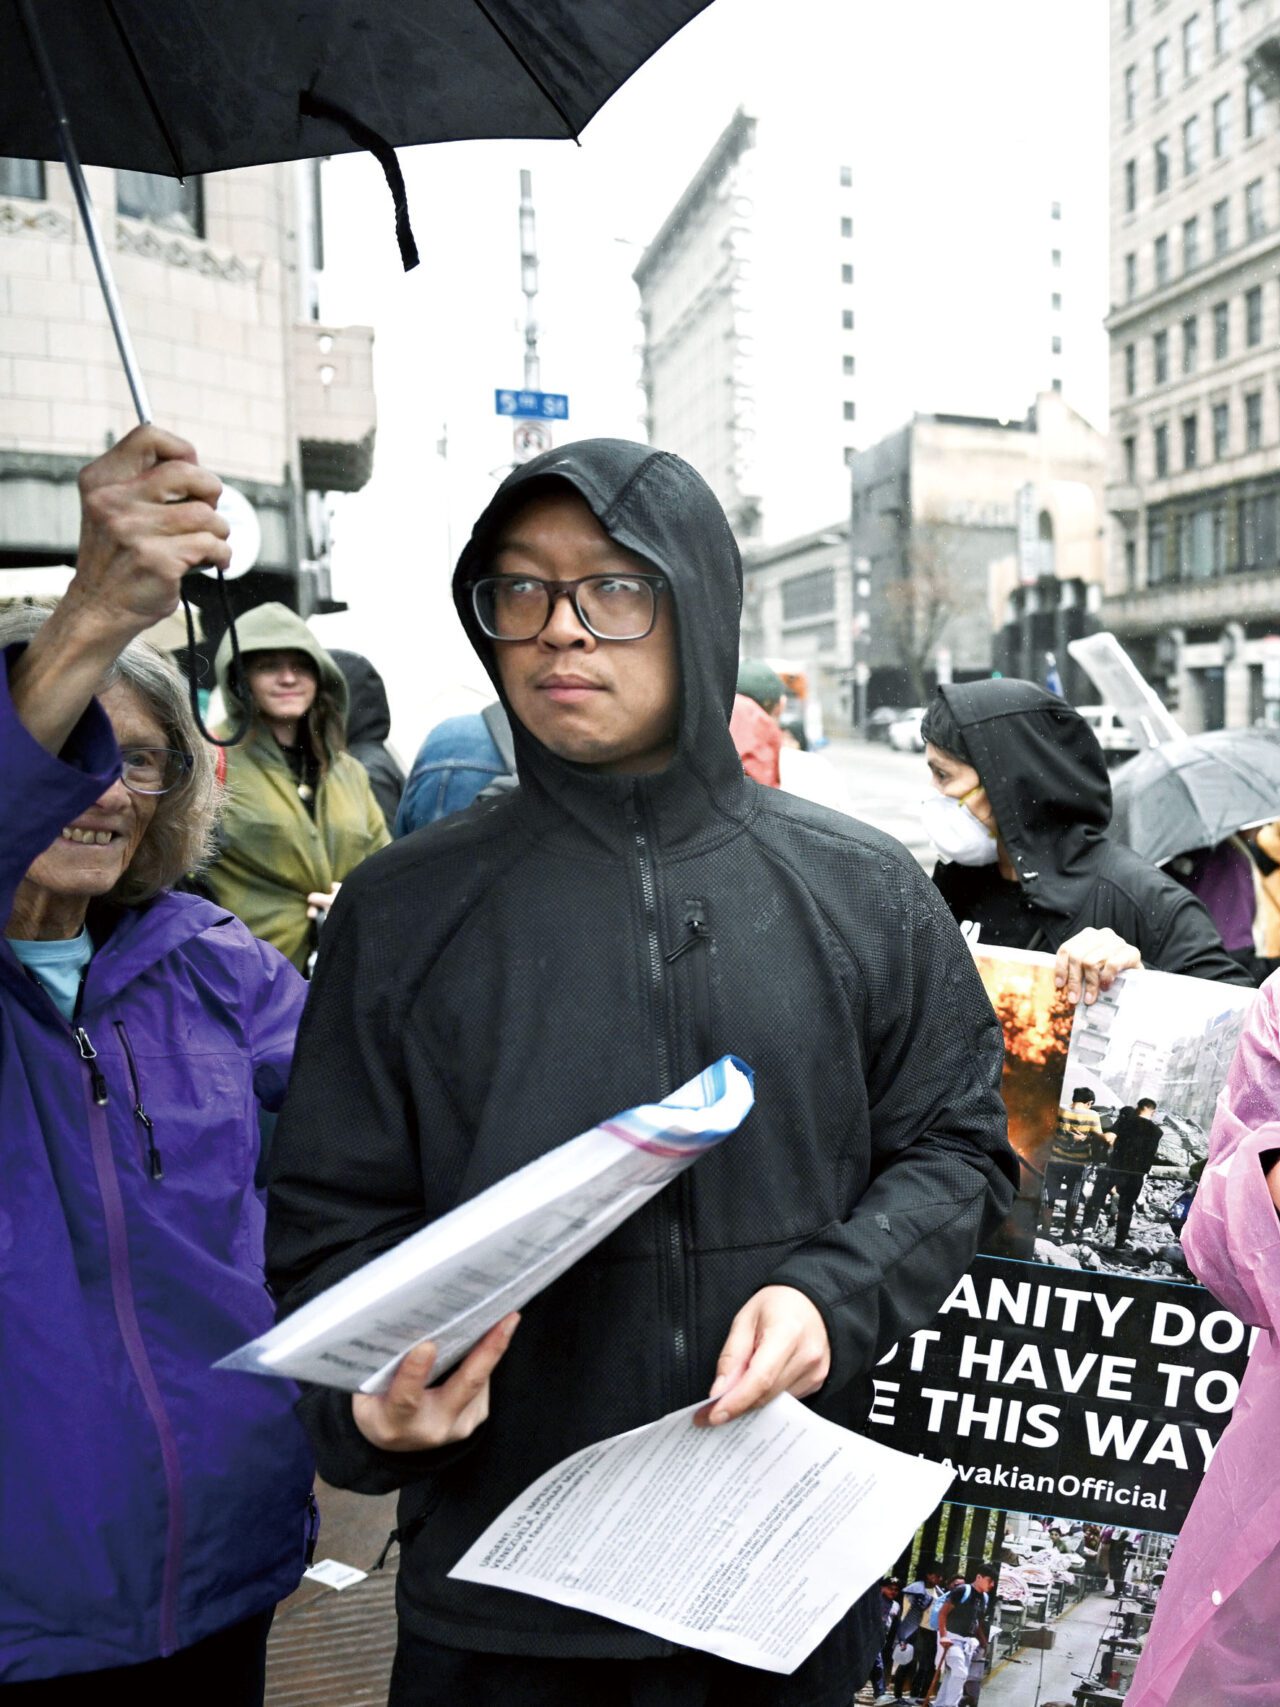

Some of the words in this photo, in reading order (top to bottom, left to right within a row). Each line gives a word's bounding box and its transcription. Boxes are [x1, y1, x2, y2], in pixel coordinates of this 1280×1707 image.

[938, 1273, 1135, 1338] ANITY
[958, 1335, 1137, 1402] HAVE
[1157, 1363, 1239, 1415] TO
[870, 1378, 900, 1426] E
[920, 1386, 1061, 1450] THIS
